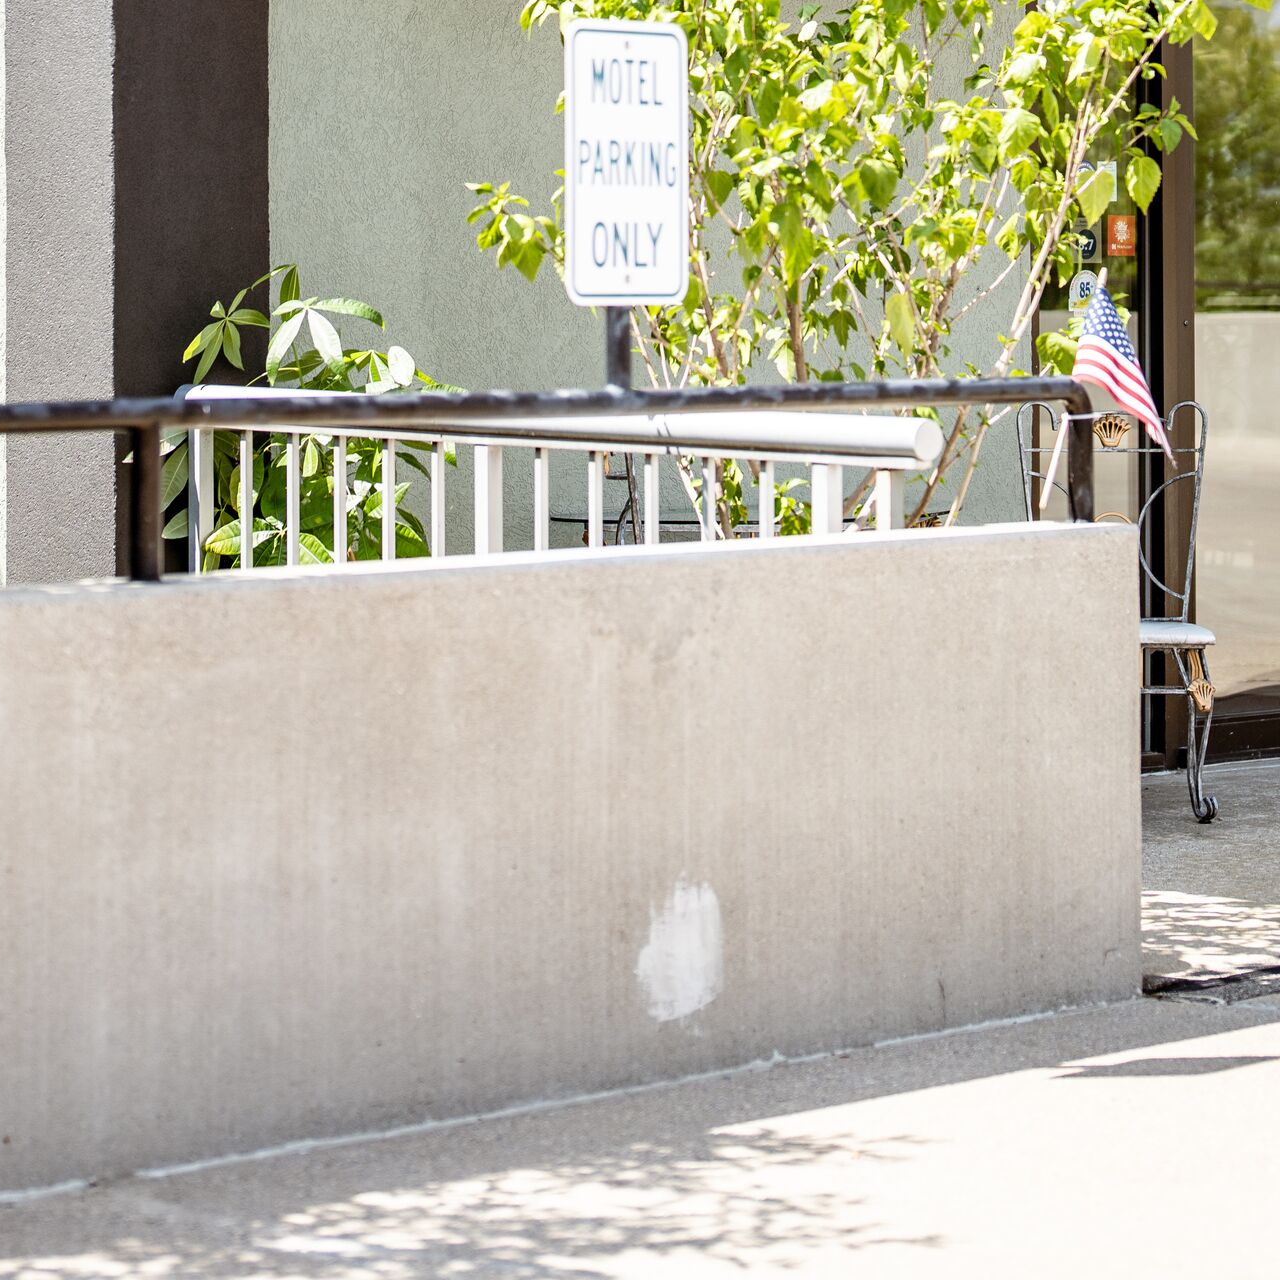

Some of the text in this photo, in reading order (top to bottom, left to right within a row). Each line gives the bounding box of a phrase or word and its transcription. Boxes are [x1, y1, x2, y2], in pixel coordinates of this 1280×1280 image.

[591, 58, 664, 106] MOTEL
[578, 139, 677, 188] PARKING
[591, 222, 664, 268] ONLY
